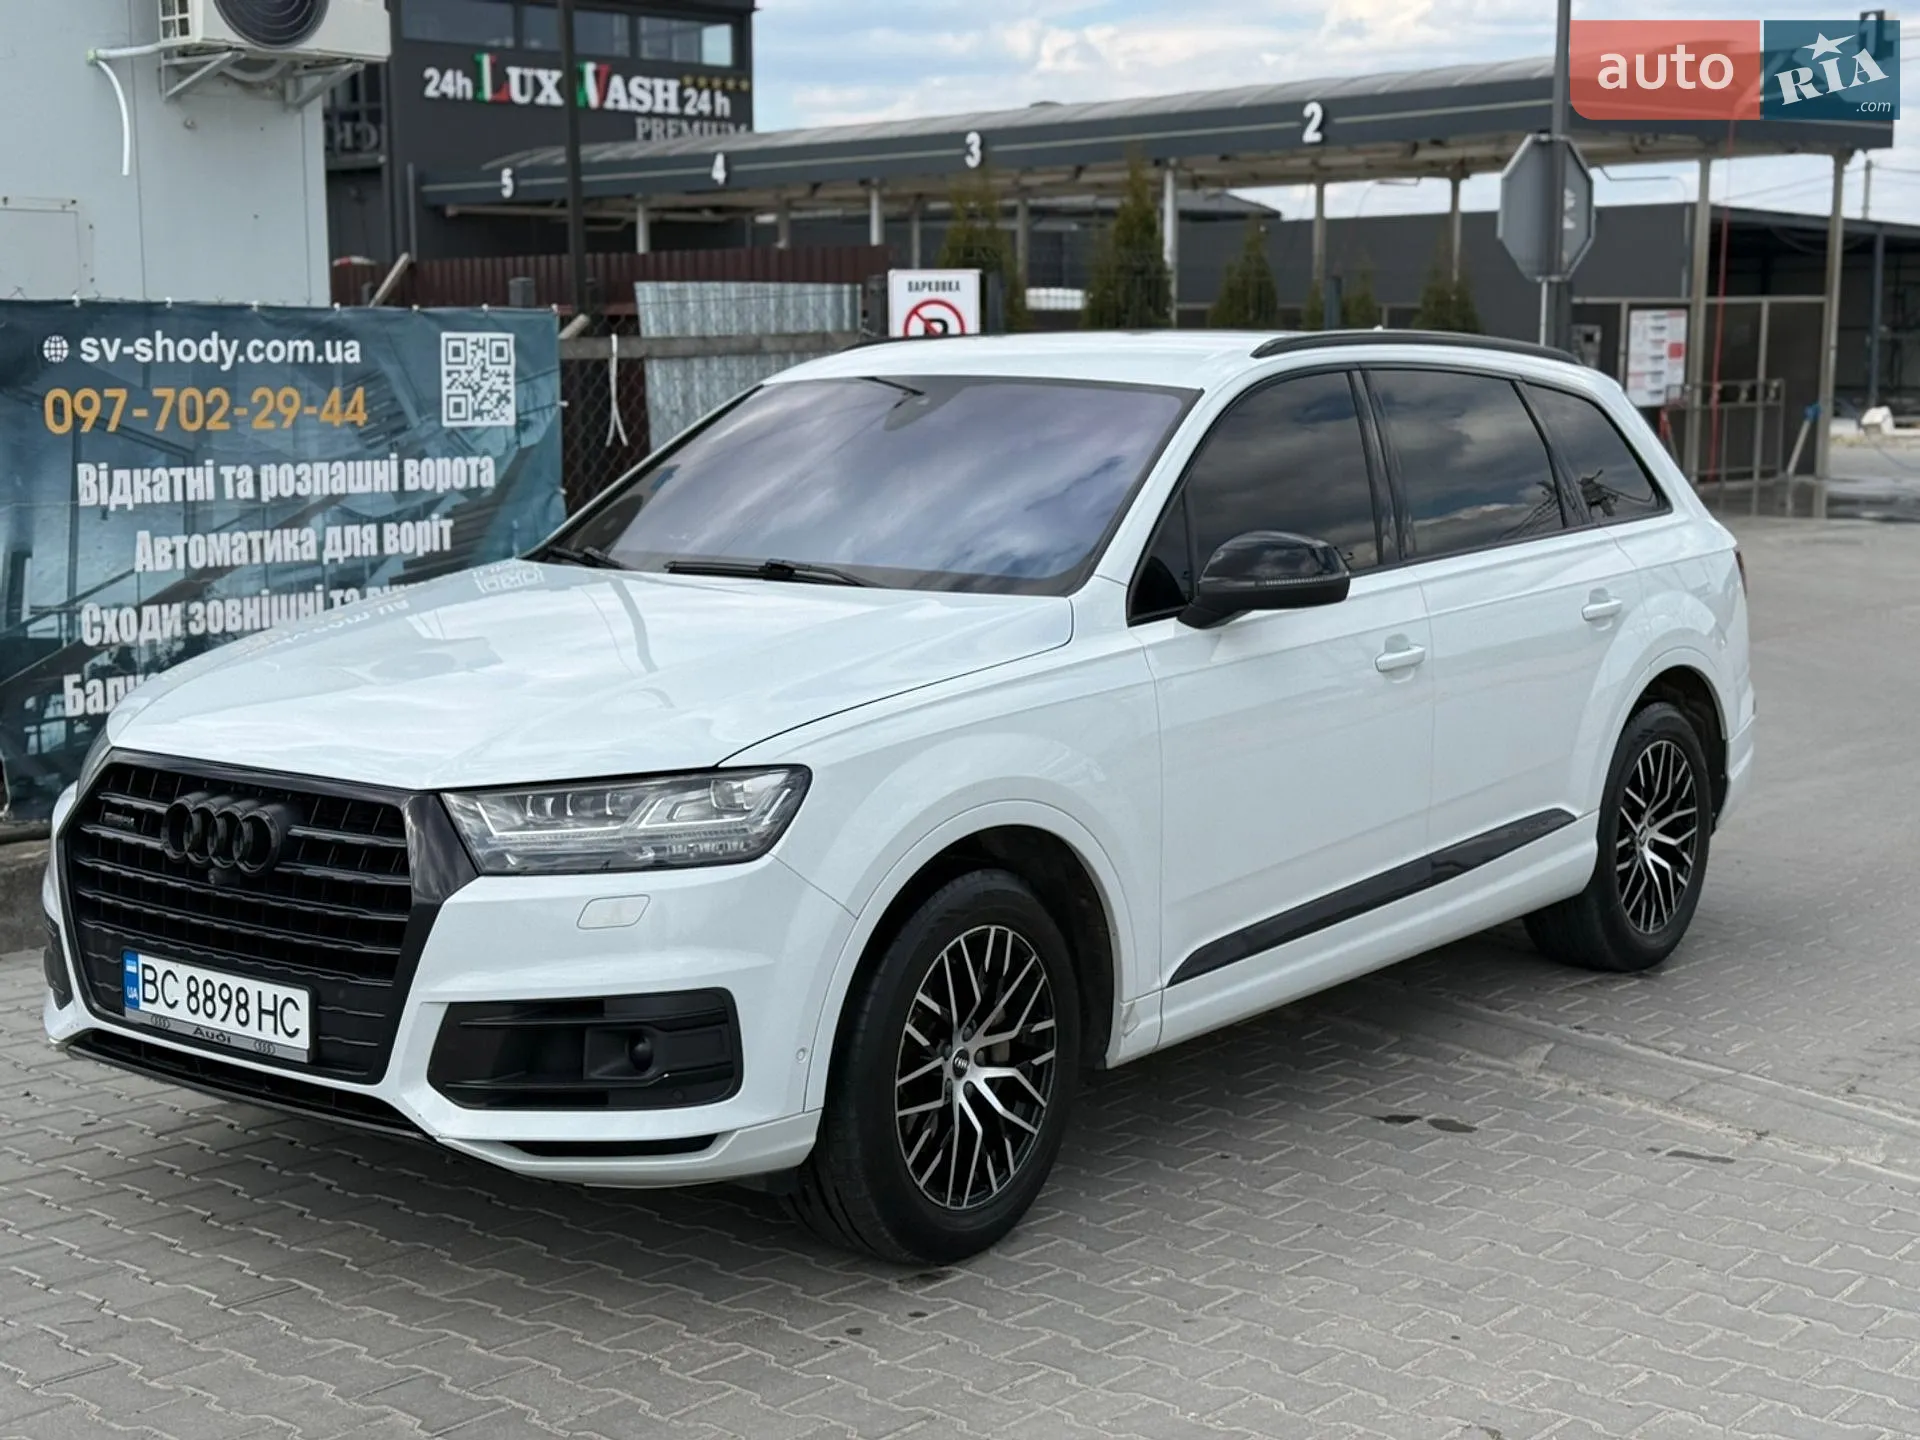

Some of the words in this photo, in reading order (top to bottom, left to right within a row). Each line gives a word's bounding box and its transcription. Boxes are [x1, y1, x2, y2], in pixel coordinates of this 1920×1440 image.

[423, 67, 473, 100] 24h
[474, 53, 564, 107] LUX
[683, 88, 731, 118] 24h
[1302, 101, 1323, 143] 2
[711, 152, 726, 185] 4
[965, 131, 982, 168] 3
[501, 168, 514, 198] 5
[80, 331, 361, 370] sv-shody.com.ua
[44, 387, 367, 433] 097-702-29-44
[77, 459, 214, 510] Відкатні
[220, 466, 252, 500] та
[261, 453, 398, 502] розпашні
[404, 456, 496, 491] ворота
[135, 527, 318, 572] Автоматика
[323, 525, 377, 565] для
[383, 517, 454, 557] воріт
[81, 602, 182, 647] Сходи
[188, 584, 324, 635] зовнішні
[64, 672, 160, 717] Бал
[127, 986, 138, 1000] UA
[141, 963, 178, 1009] BC
[186, 975, 250, 1028] 8898
[257, 989, 300, 1038] HC
[193, 1026, 232, 1044] Audi
